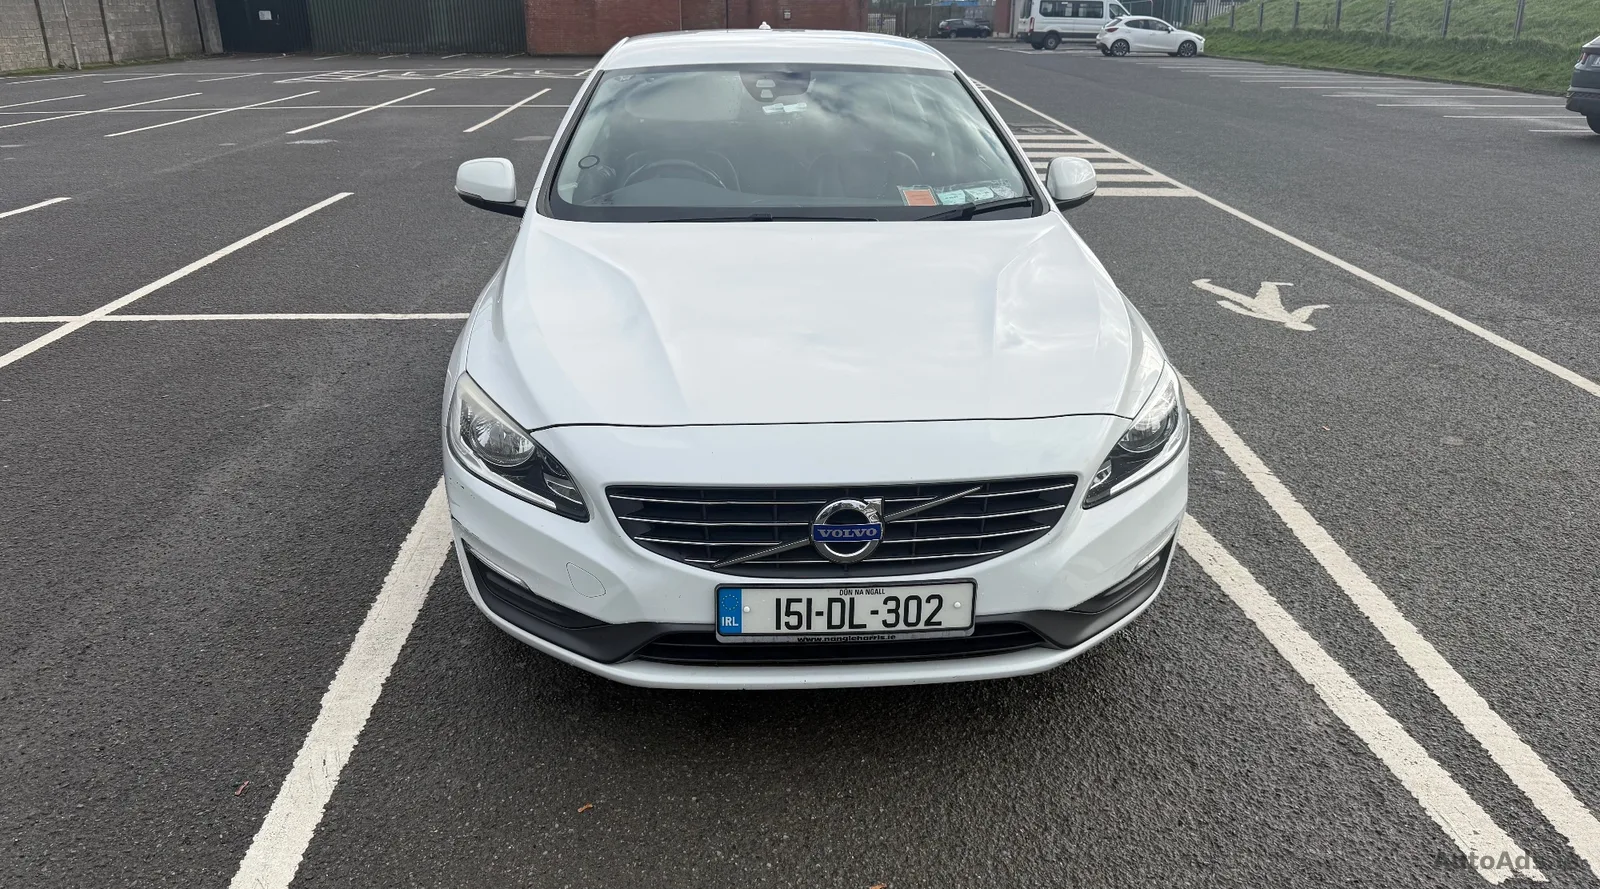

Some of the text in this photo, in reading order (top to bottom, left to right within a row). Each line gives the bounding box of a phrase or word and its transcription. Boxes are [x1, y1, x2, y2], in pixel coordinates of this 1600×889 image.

[817, 527, 878, 538] VOLVO
[865, 588, 886, 596] NGALL
[775, 594, 944, 631] 151-DL-302
[721, 616, 739, 627] IRL
